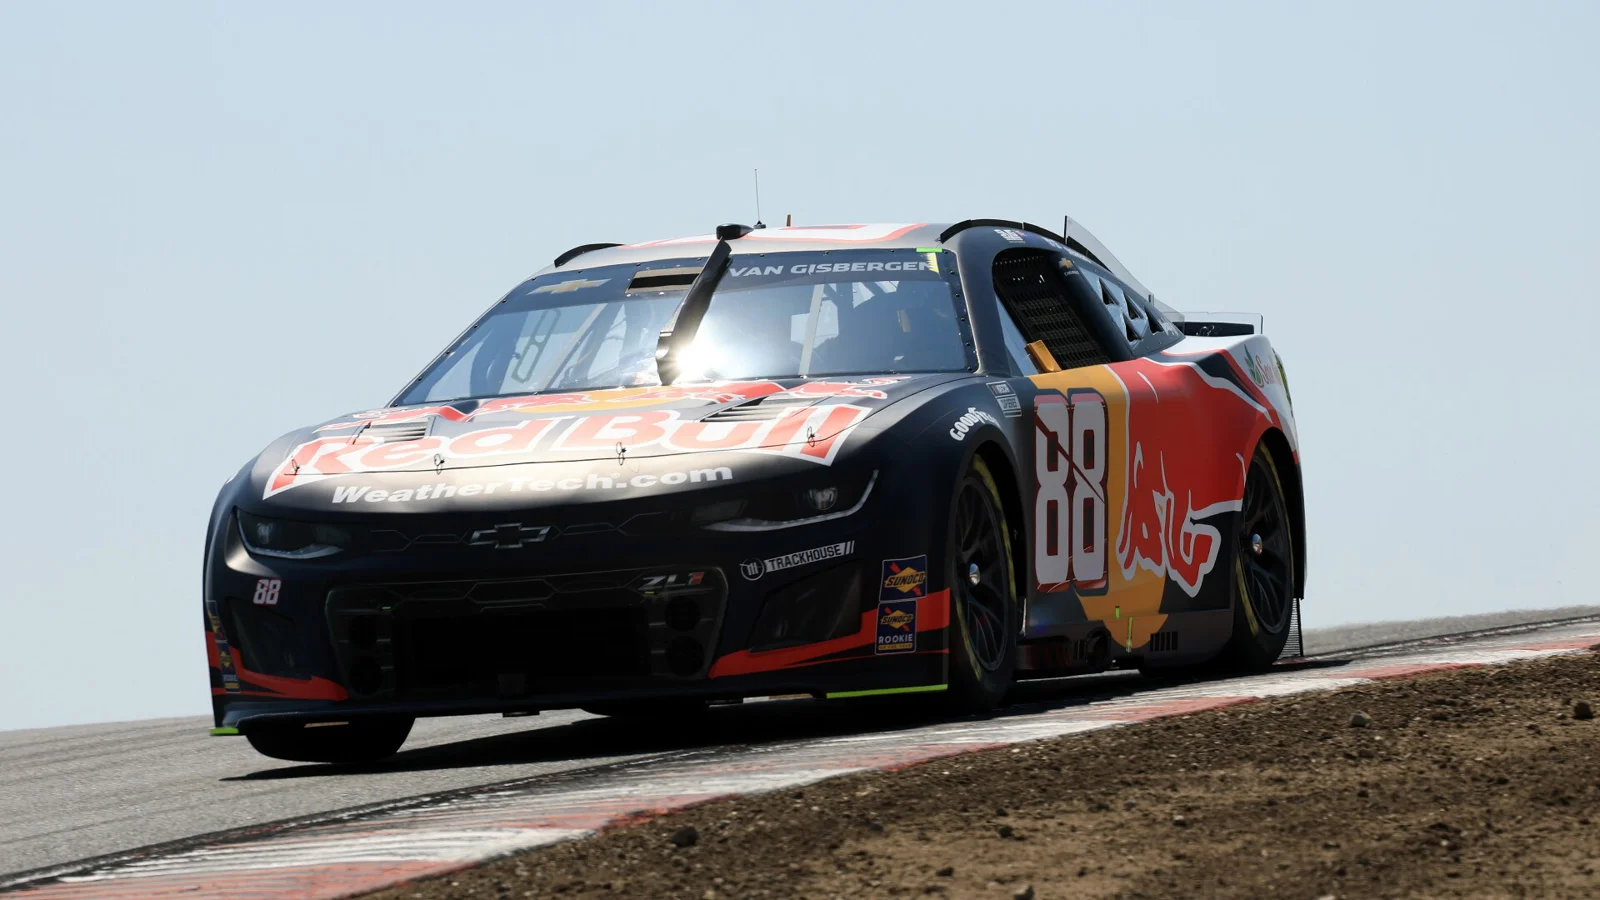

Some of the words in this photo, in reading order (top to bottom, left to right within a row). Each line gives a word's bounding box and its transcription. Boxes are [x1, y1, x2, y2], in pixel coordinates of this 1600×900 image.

[729, 265, 784, 277] VAN
[263, 415, 570, 499] Red
[549, 403, 872, 466] Bull
[1034, 396, 1107, 590] 88
[768, 544, 842, 570] TRACKHOUSE
[637, 571, 705, 591] ZL1
[887, 573, 925, 587] SUNOCO
[252, 578, 283, 606] 88
[882, 615, 912, 624] SUNOCO
[878, 634, 914, 644] ROOKIE
